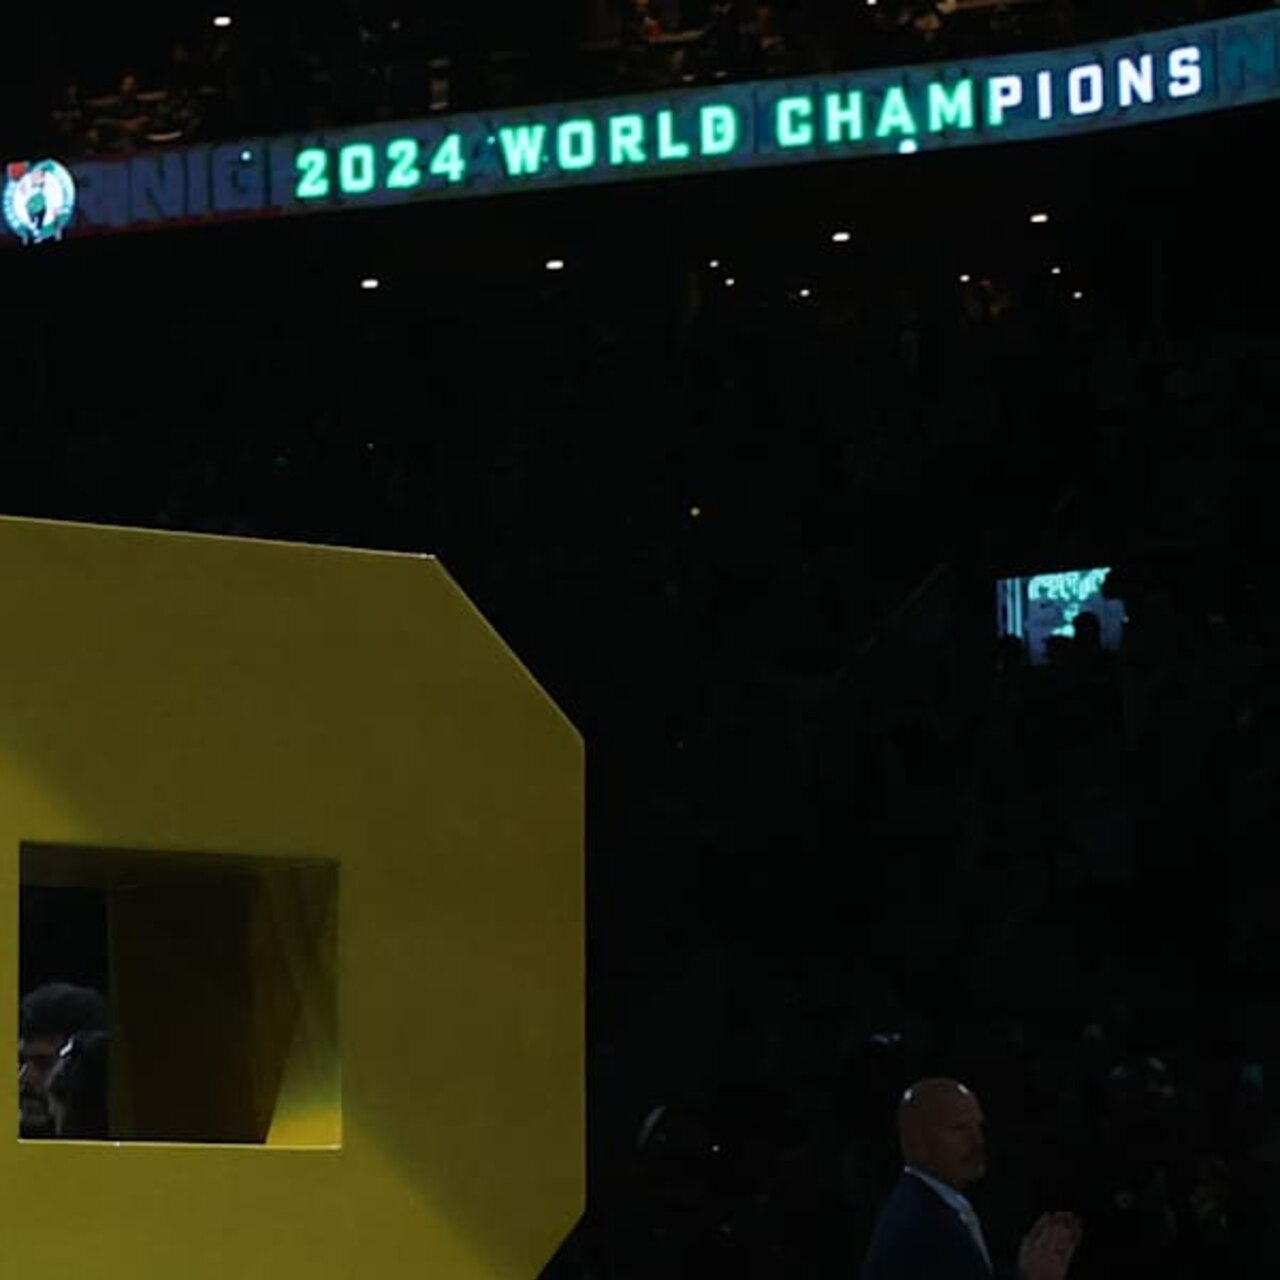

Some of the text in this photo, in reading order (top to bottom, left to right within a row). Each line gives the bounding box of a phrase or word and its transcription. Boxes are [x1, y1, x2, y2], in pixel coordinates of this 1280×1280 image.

[295, 133, 466, 198] 2024
[498, 105, 737, 176] WORLD
[775, 46, 1203, 148] CHAMPIONS
